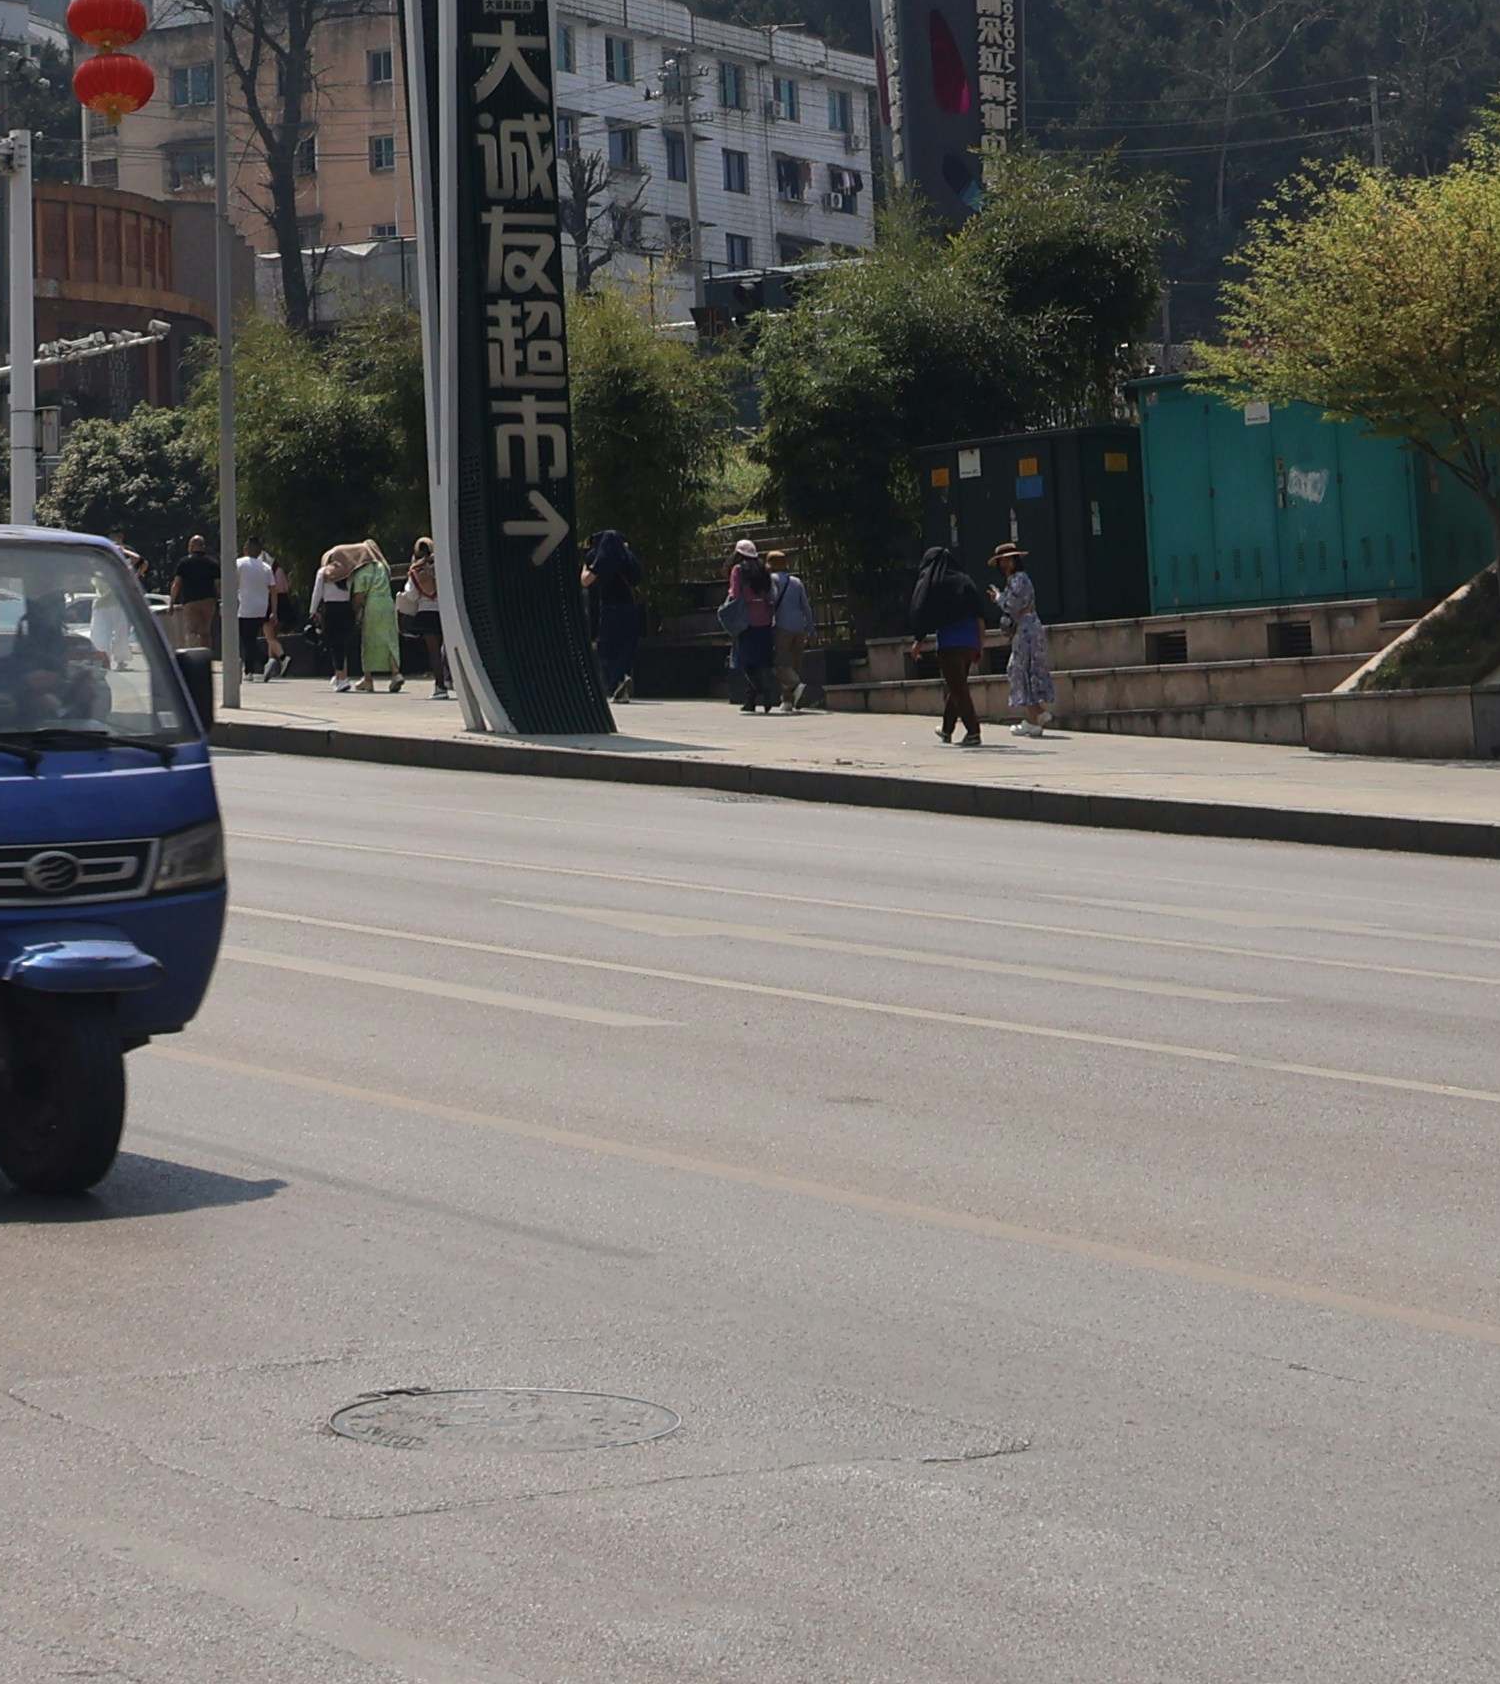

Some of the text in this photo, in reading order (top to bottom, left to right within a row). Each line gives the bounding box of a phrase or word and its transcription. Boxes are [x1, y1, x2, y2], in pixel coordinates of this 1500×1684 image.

[1005, 81, 1019, 131] MALL
[471, 19, 569, 485] 大诚友超市
